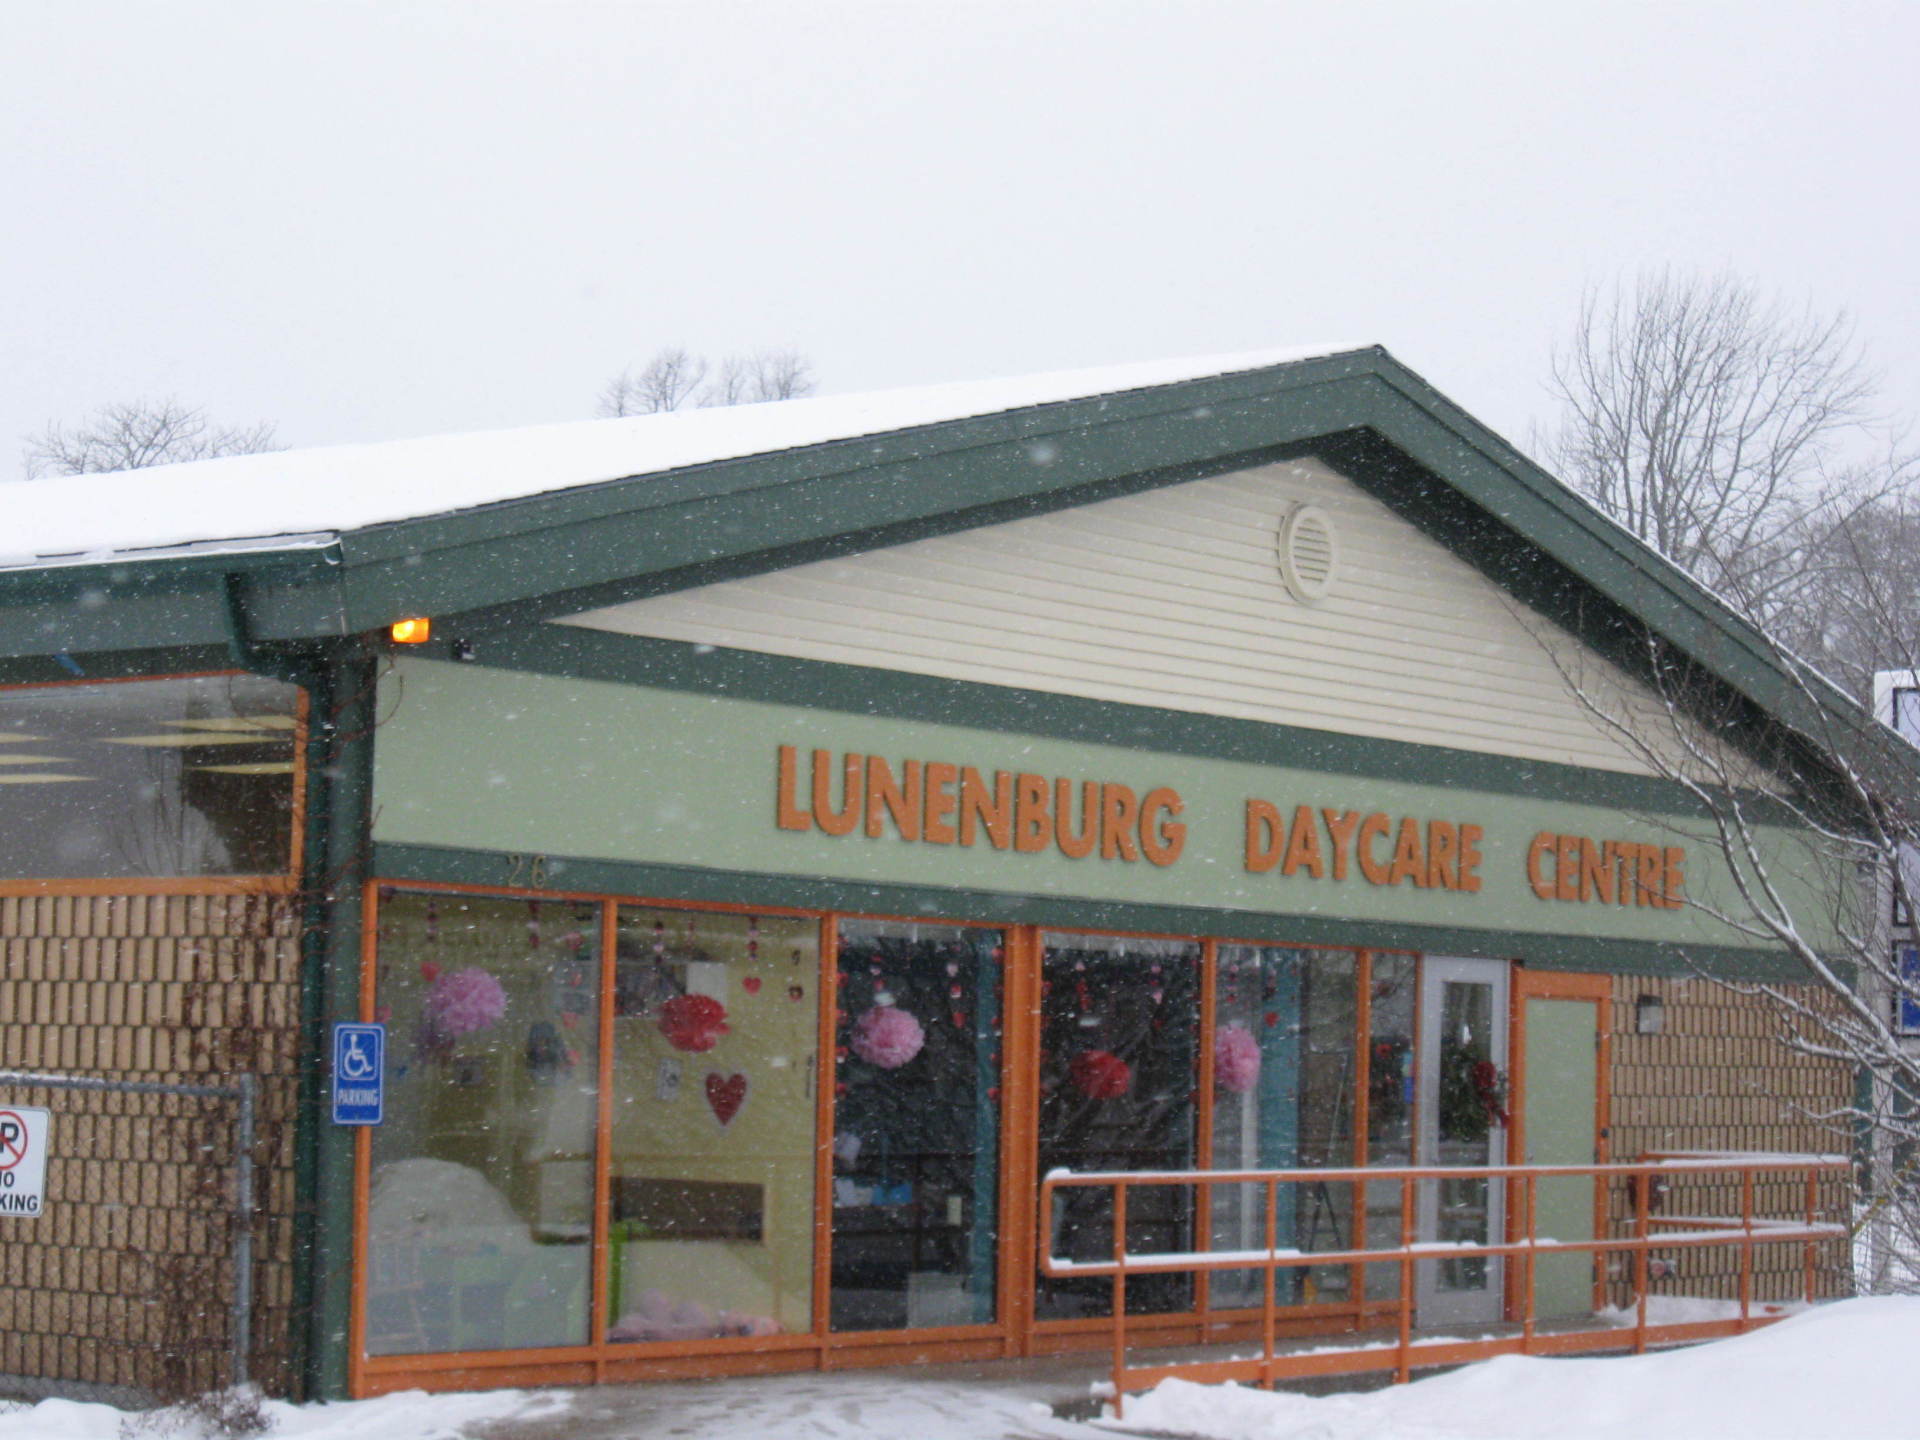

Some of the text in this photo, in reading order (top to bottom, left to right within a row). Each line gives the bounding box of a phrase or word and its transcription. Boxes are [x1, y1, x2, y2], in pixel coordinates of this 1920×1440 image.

[777, 744, 1687, 910] LUNENBURG DAYCARE CENTRE
[0, 1170, 15, 1188] O
